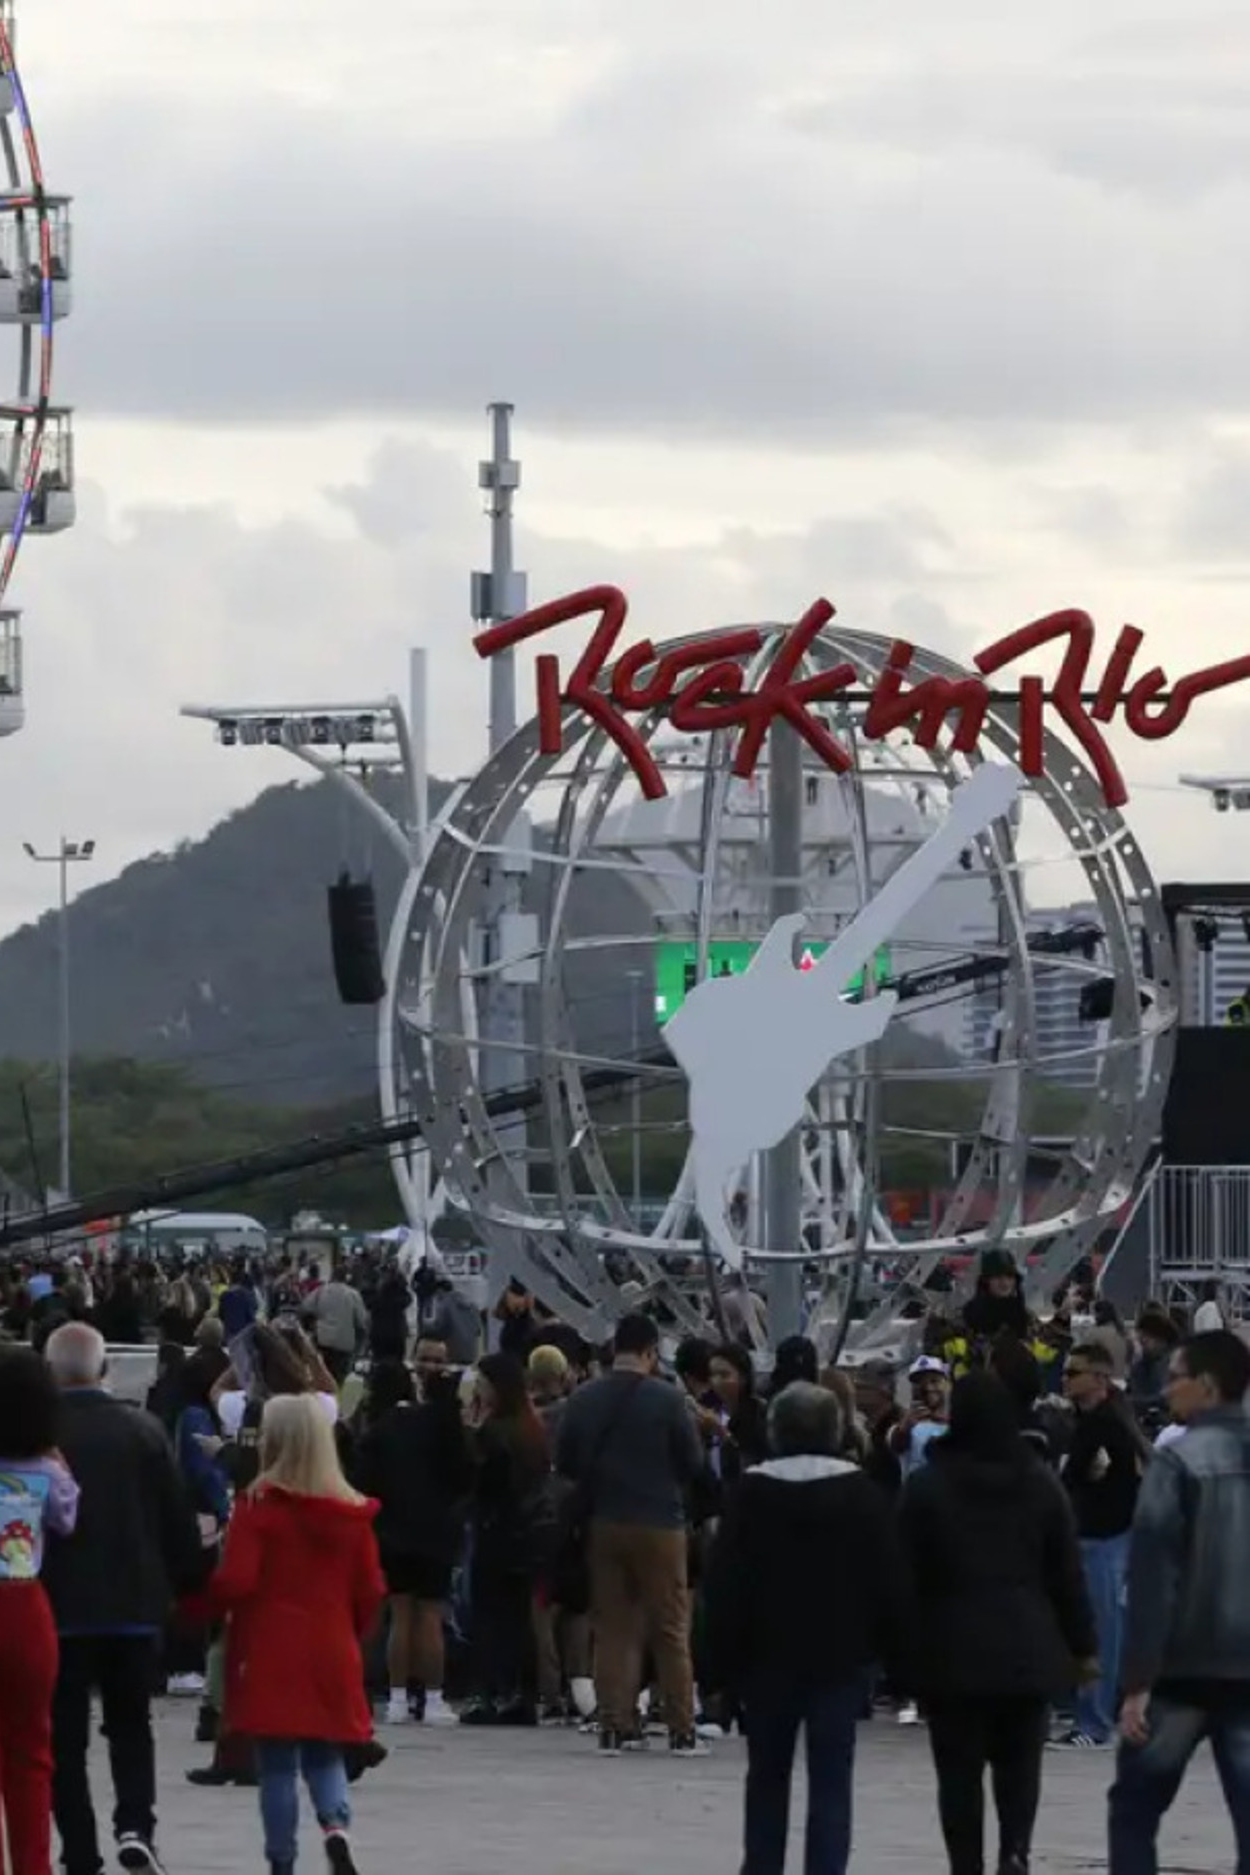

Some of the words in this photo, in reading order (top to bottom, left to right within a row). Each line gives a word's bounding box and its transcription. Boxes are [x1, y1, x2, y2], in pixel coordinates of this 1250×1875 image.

[473, 585, 856, 800] Rock
[863, 640, 990, 753] in
[973, 609, 1250, 807] Rio
